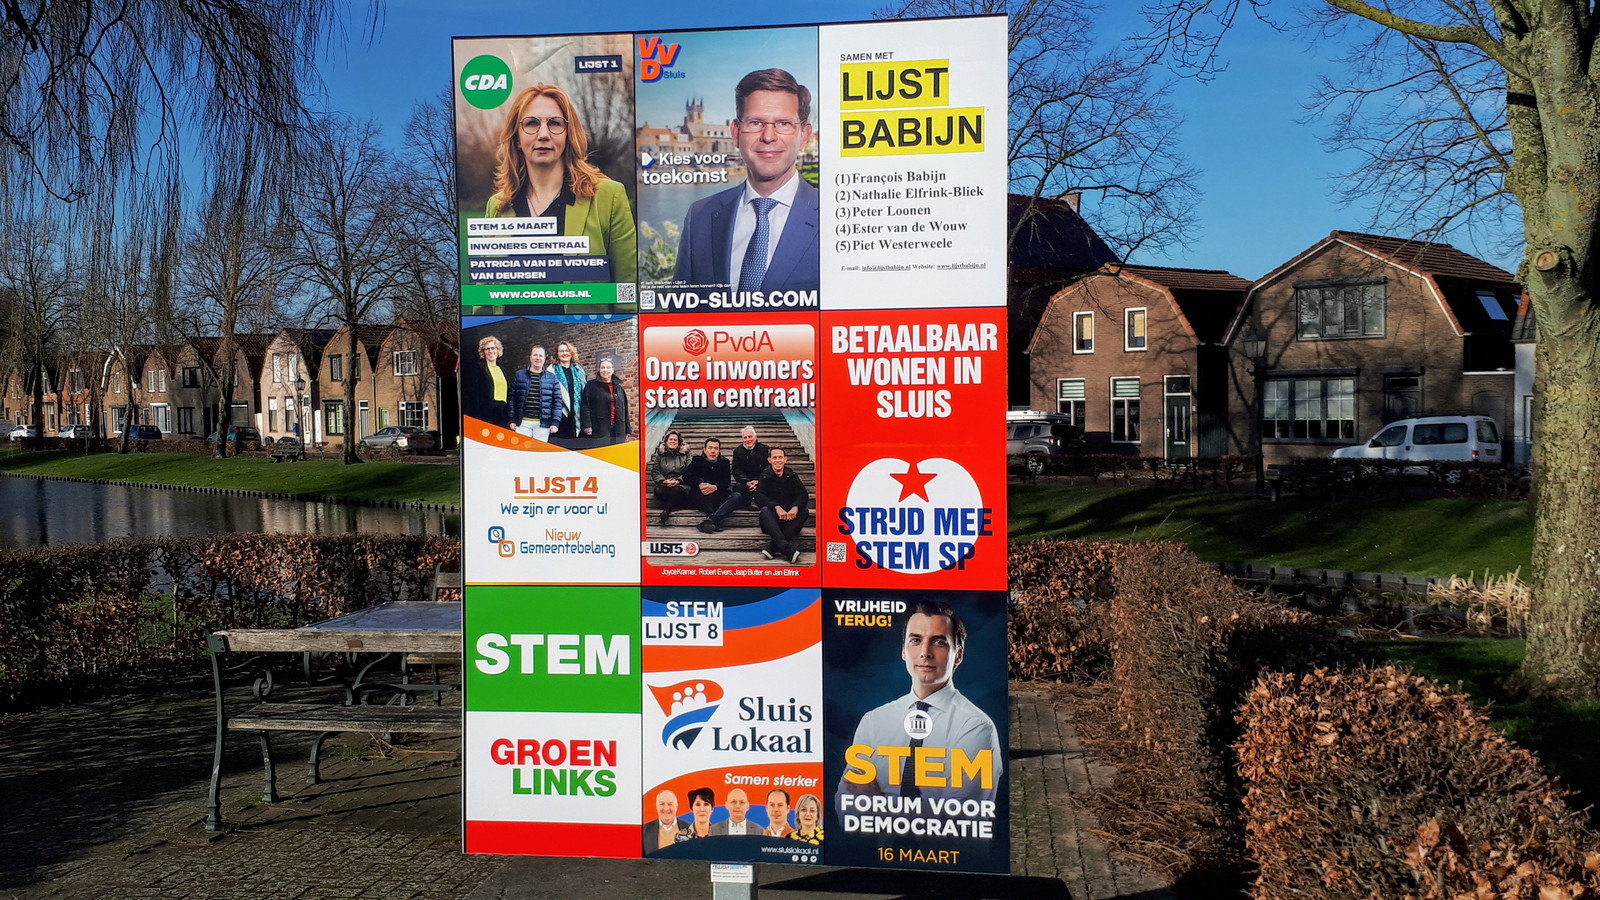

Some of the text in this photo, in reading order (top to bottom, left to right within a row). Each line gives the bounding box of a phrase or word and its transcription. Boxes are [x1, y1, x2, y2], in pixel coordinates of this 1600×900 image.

[611, 60, 618, 68] 1
[638, 37, 682, 83] VVD
[840, 52, 894, 61] SAMEN MET
[465, 74, 507, 90] CDA
[664, 70, 686, 79] Sluis
[843, 68, 948, 101] LIJST
[843, 115, 982, 149] BABIJN
[660, 153, 727, 165] Kies voor
[642, 169, 727, 184] toekomst
[907, 171, 946, 183] Babijn
[905, 186, 984, 199] Elfrink-Bliek
[887, 206, 931, 216] Loonen
[517, 222, 555, 230] MAART
[911, 222, 925, 232] de
[929, 221, 968, 231] Wouw
[879, 238, 953, 250] Westerweele
[470, 259, 607, 268] PATRICIA VAN DE VIJVER-
[471, 272, 494, 280] VAN
[489, 290, 591, 299] WWW.CDASLUIS.NL
[658, 290, 817, 309] VVD-SLUIS.COM
[713, 331, 774, 352] PvdA
[832, 323, 998, 353] BETAALBAAR
[646, 356, 814, 381] Onze inwoners
[847, 356, 982, 386] WONEN IN
[645, 383, 816, 408] staan centraal!
[876, 390, 952, 418] SLUIS
[514, 477, 599, 493] LIJST 4
[501, 503, 608, 517] We zijn er voor u!
[838, 507, 993, 536] STRIJD MEE
[546, 528, 581, 541] Nieuw
[520, 541, 616, 557] Gemeentebelang
[856, 541, 975, 570] STEM SP
[734, 568, 747, 576] Jaap
[773, 568, 783, 576] Jan
[666, 601, 723, 618] STEM
[834, 600, 907, 613] VRIJHEID
[835, 614, 892, 627] TERUG!
[646, 623, 718, 639] LIJST 8
[475, 633, 630, 675] STEM
[739, 696, 812, 722] Sluis
[712, 727, 813, 753] Lokaal
[490, 738, 617, 766] GROEN
[844, 744, 994, 789] STEM
[512, 768, 617, 797] LINKS
[724, 773, 818, 787] Samen sterker
[840, 794, 996, 818] FORUM VOOR
[844, 815, 993, 839] DEMOCRATIE
[761, 846, 818, 854] www.sluislokaal.nl
[878, 848, 960, 864] 16 MAART
